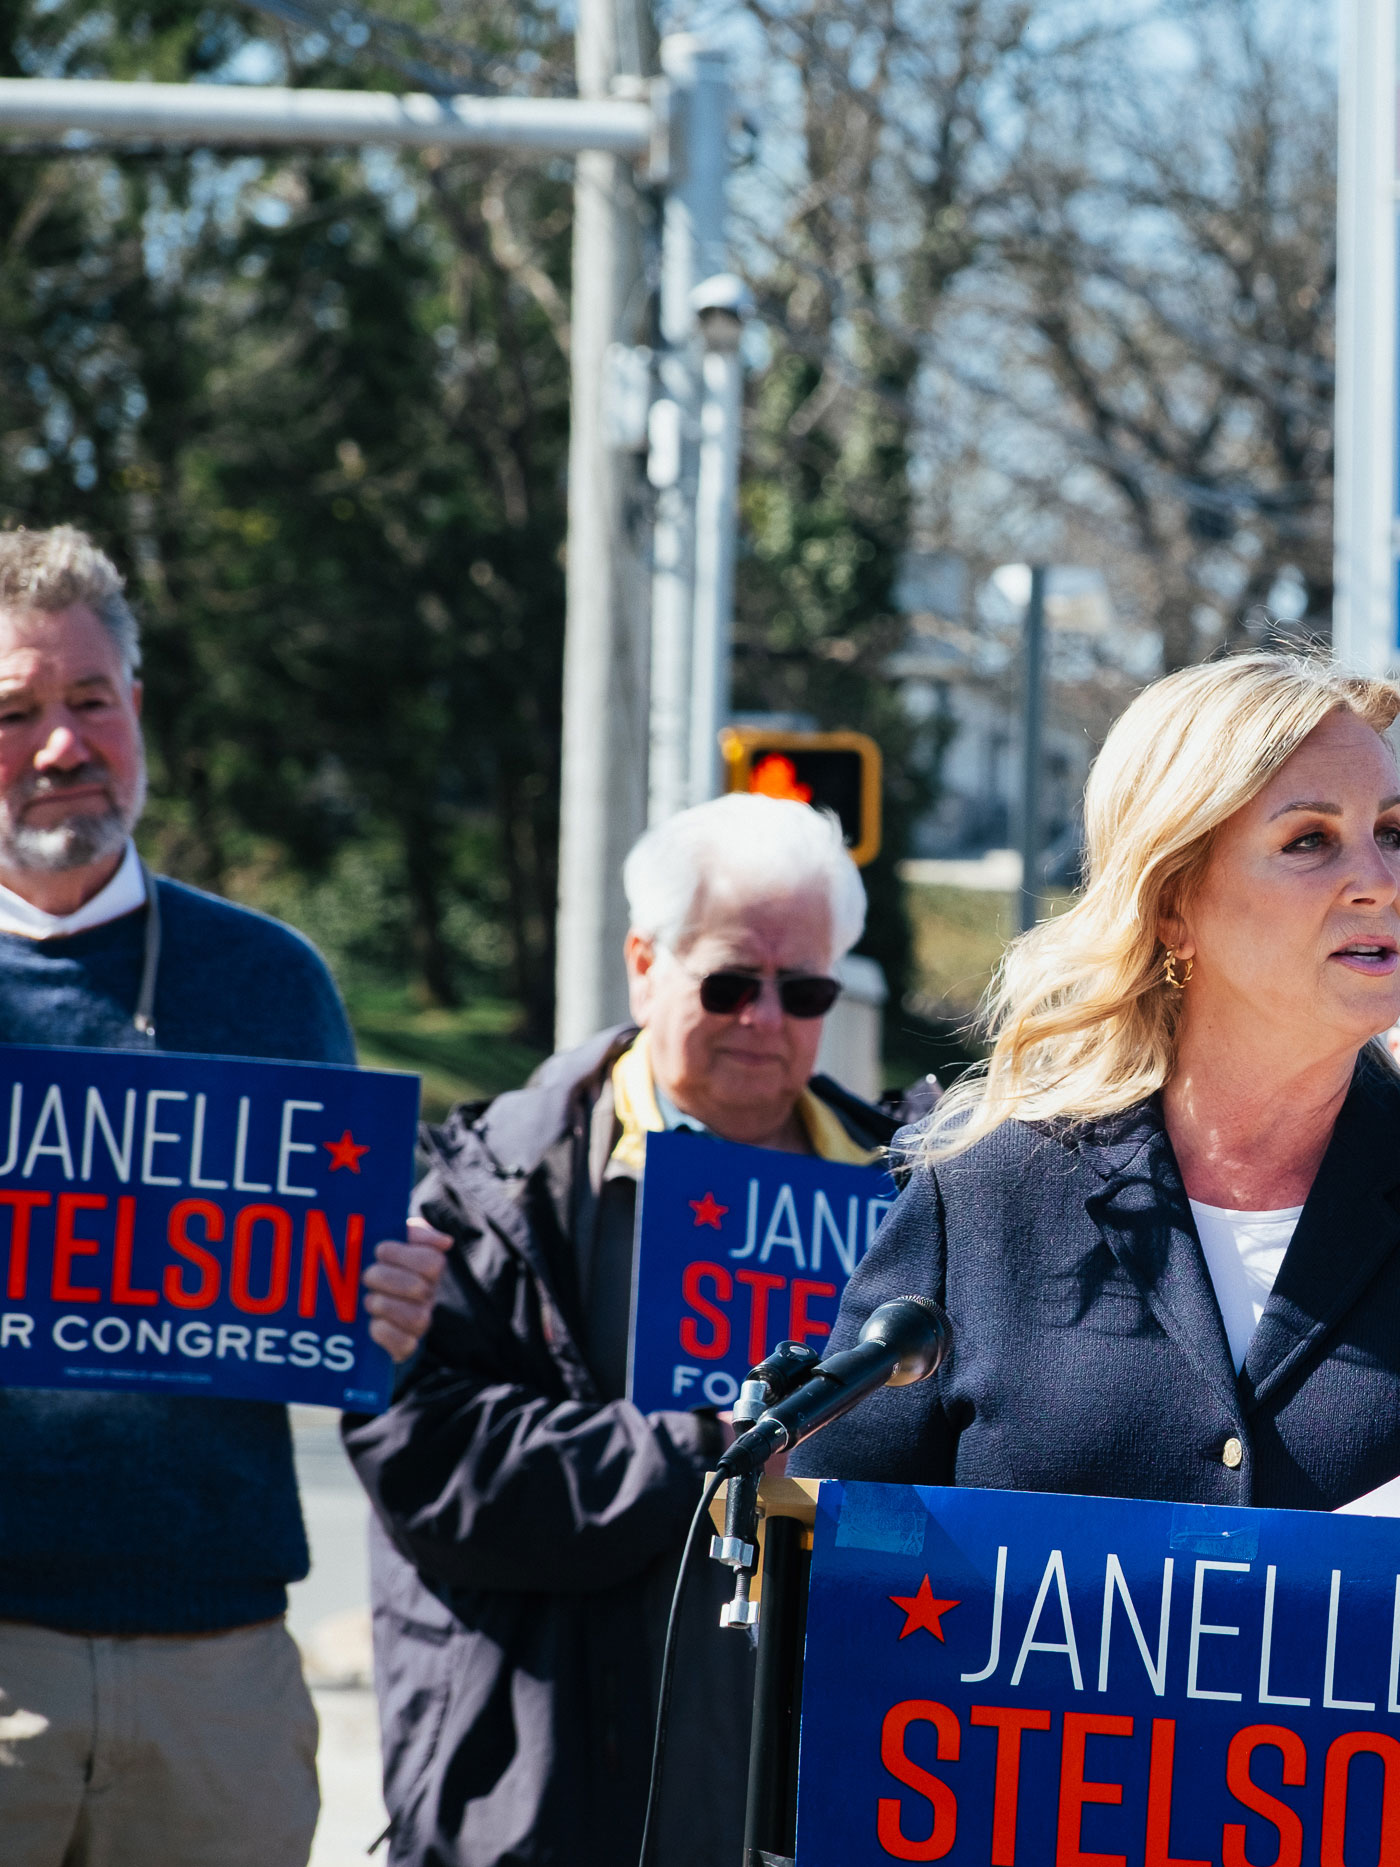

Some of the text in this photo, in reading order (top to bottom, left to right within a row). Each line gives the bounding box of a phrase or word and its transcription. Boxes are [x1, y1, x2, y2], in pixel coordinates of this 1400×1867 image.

[0, 1082, 324, 1197] JANELLE
[0, 1189, 365, 1323] TELSON
[52, 1314, 354, 1372] CONGRESS
[672, 1364, 739, 1405] FO
